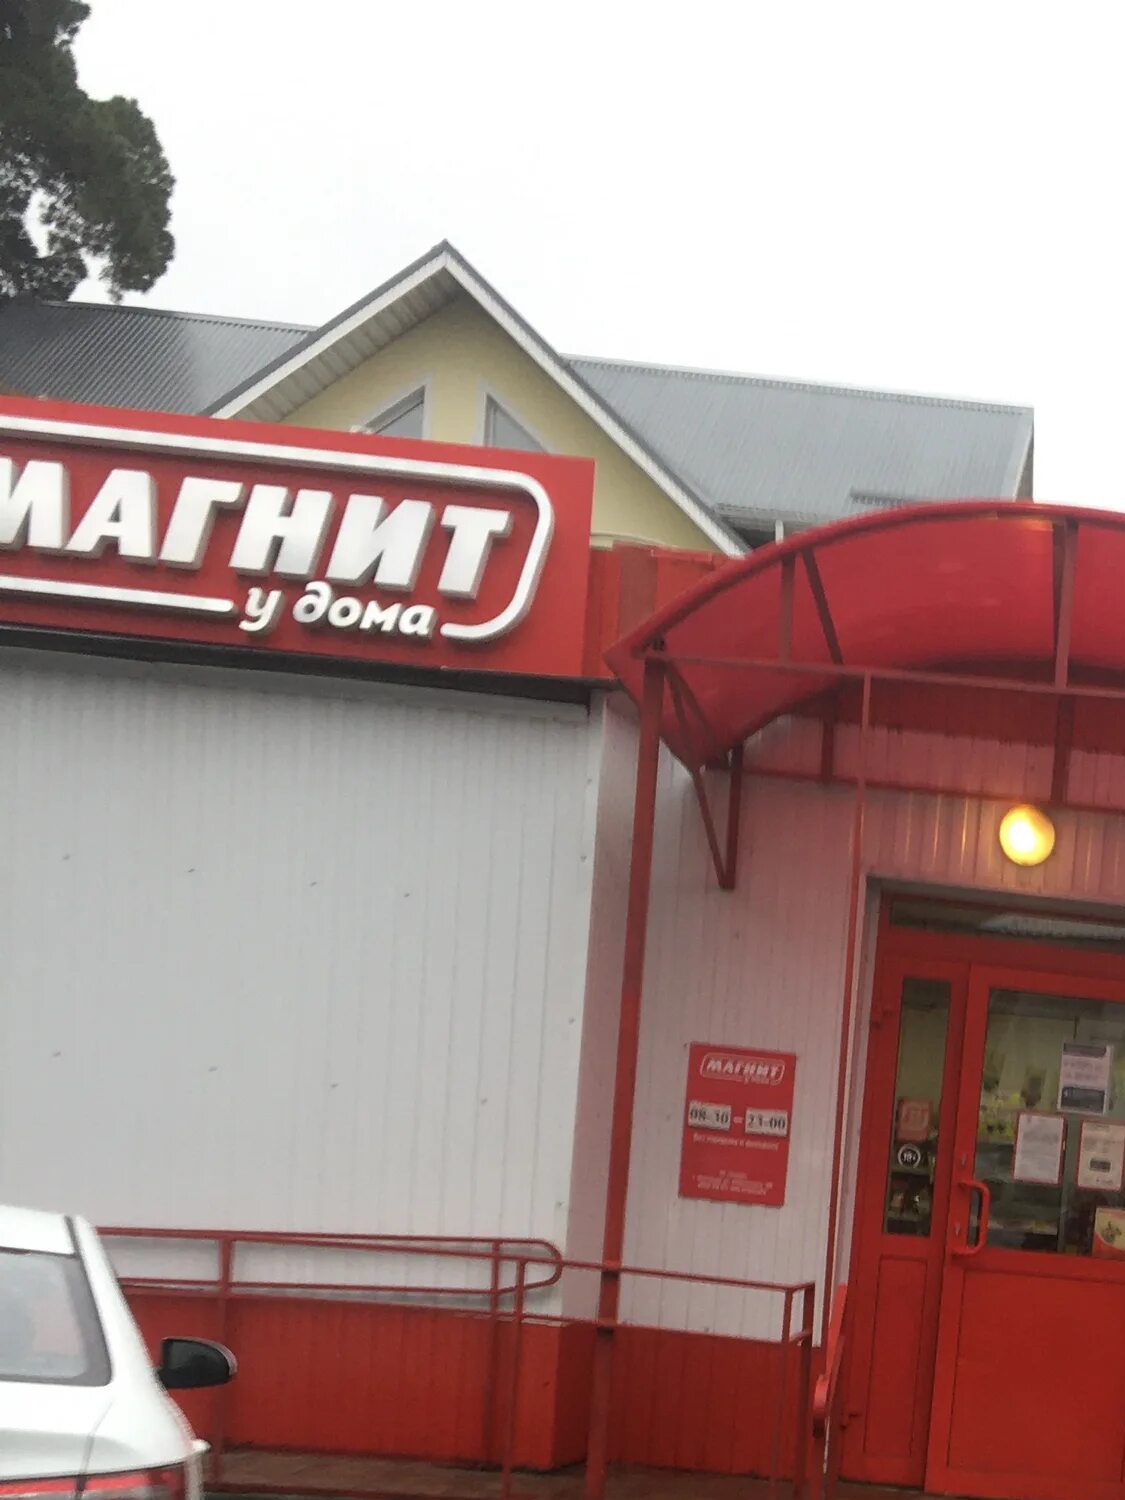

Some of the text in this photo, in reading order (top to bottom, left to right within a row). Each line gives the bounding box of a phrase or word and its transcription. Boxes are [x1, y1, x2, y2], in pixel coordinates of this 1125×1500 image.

[239, 580, 437, 637] у дома
[705, 1057, 781, 1079] МАГНИТ
